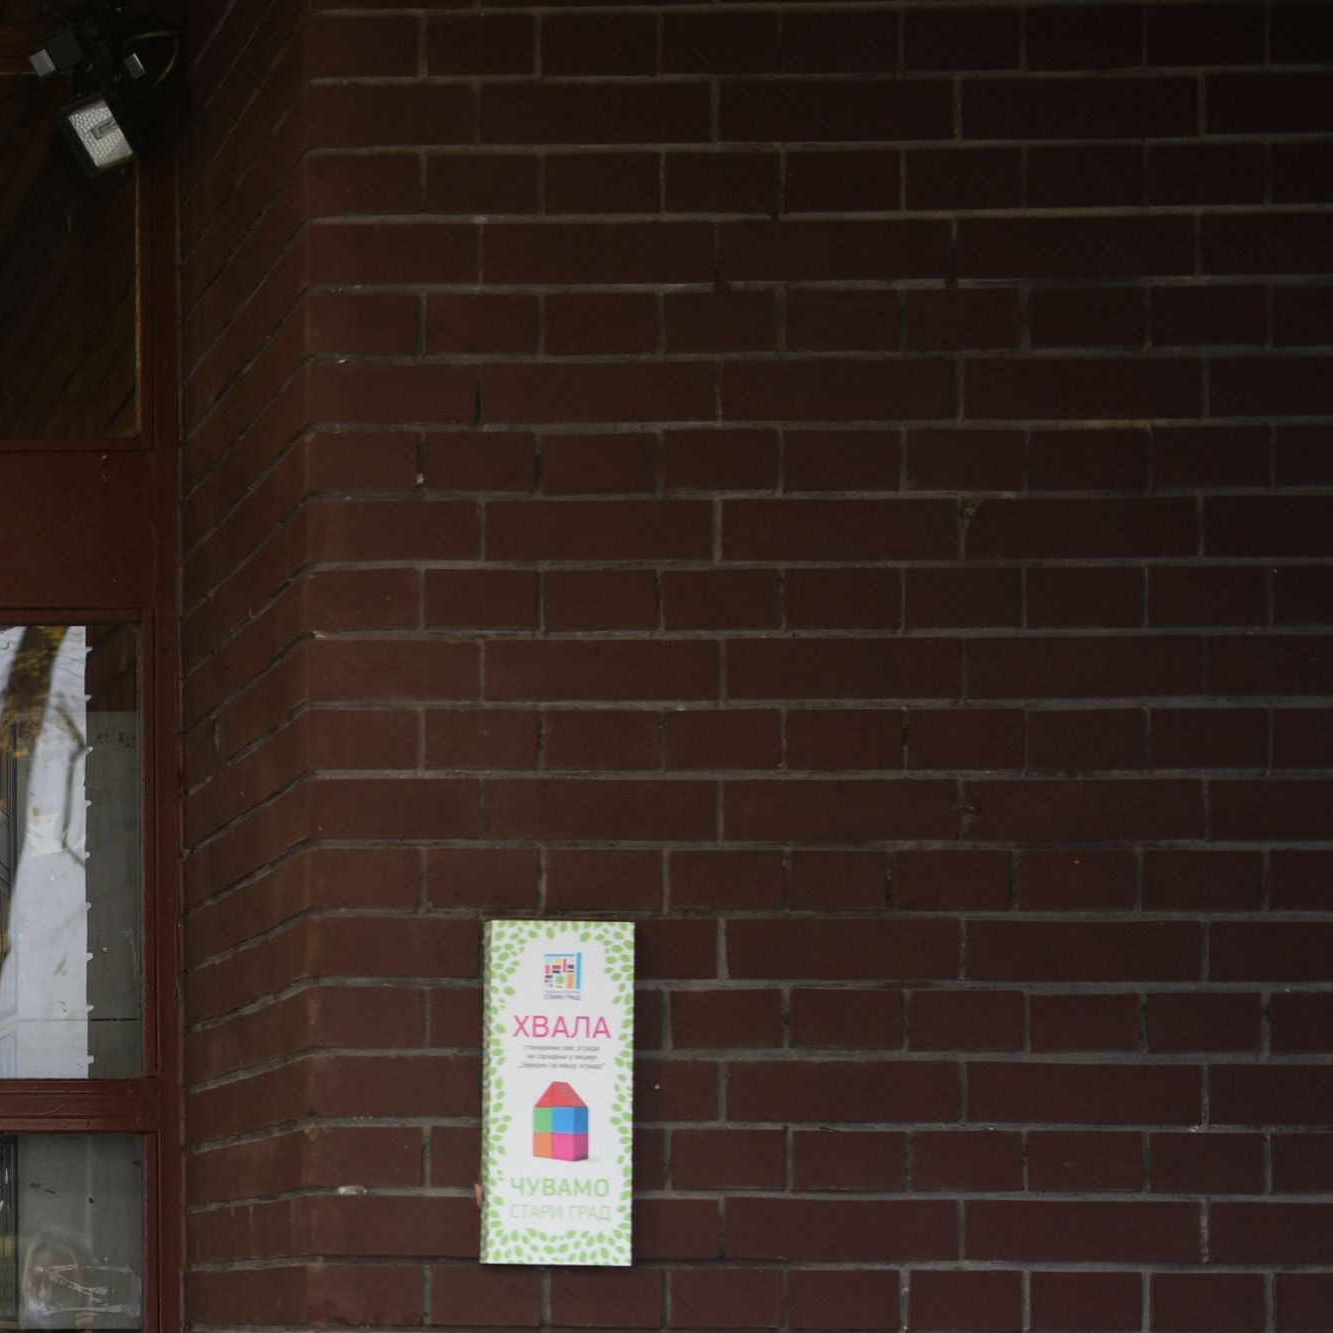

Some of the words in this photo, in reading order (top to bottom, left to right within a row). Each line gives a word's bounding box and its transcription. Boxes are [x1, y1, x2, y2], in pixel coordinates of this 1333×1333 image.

[513, 1014, 611, 1039] ХВАЛА
[510, 1178, 610, 1197] ЧУВАМО
[510, 1204, 564, 1219] СТАРИ
[569, 1205, 611, 1221] ГРАД
